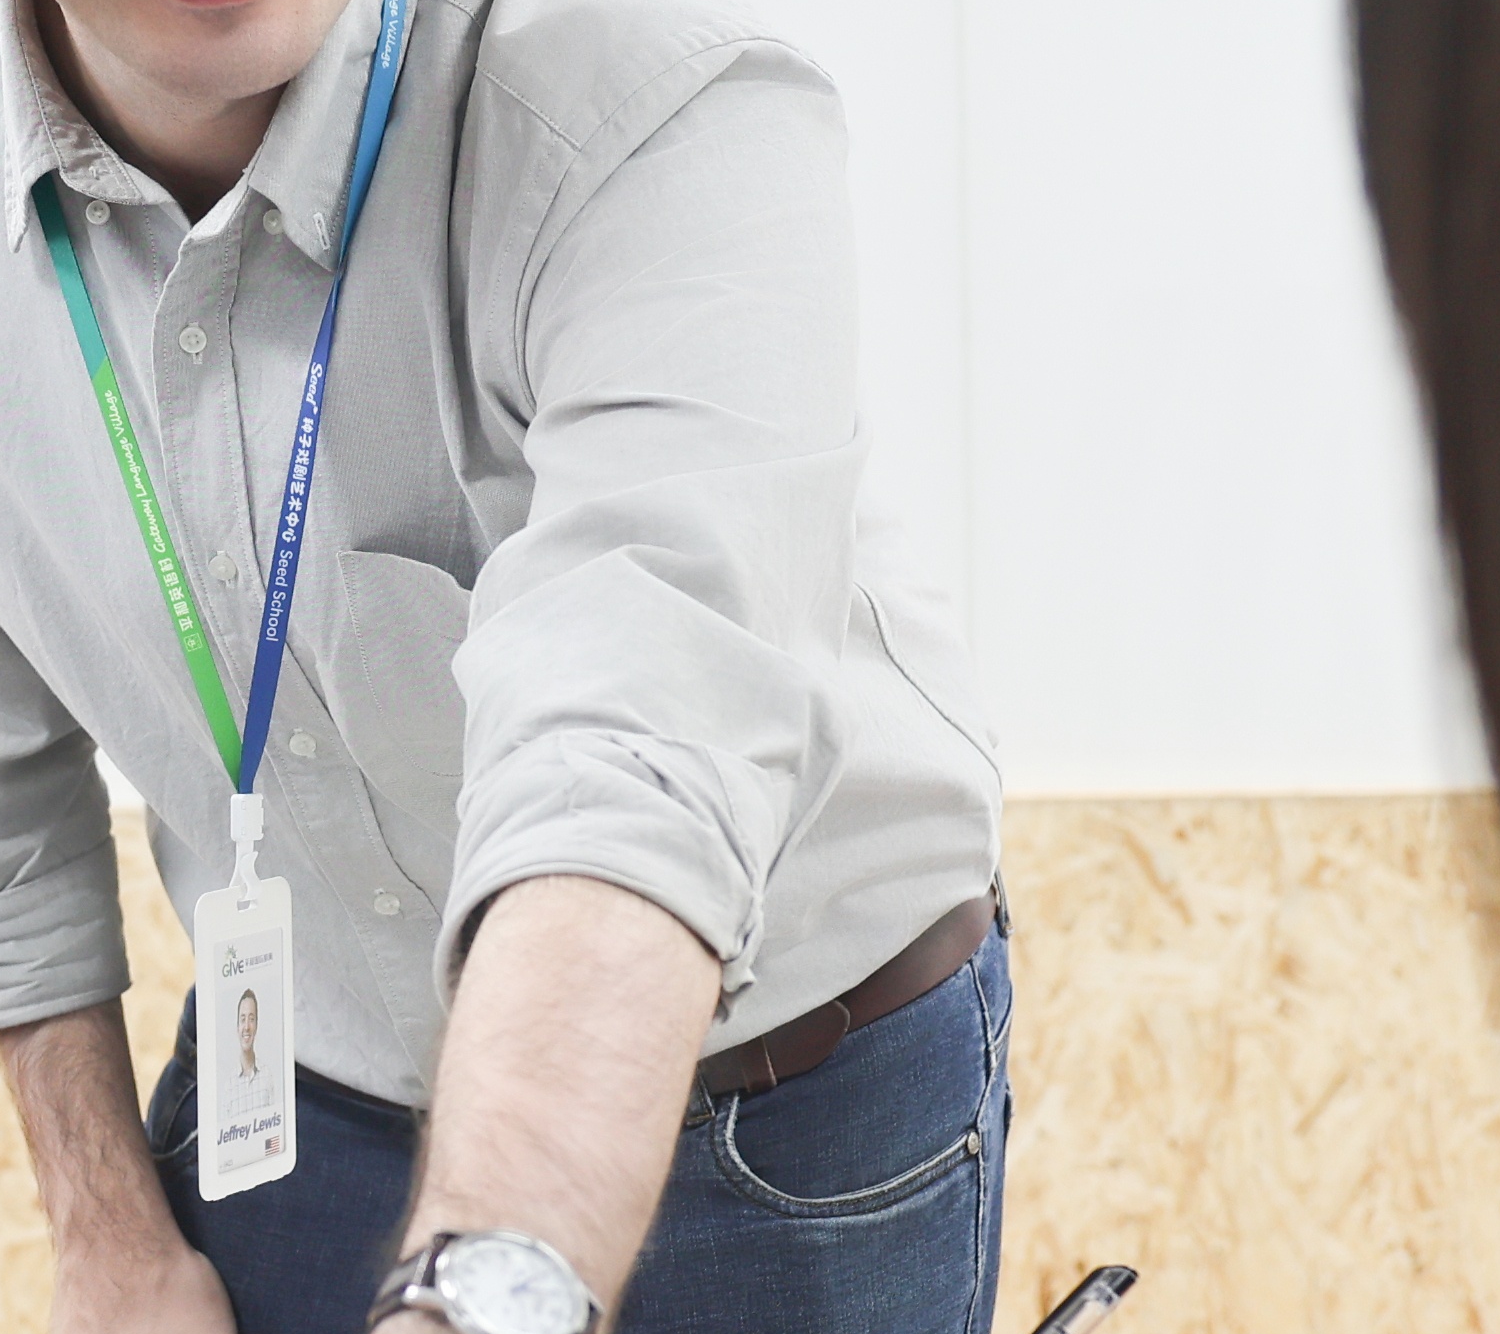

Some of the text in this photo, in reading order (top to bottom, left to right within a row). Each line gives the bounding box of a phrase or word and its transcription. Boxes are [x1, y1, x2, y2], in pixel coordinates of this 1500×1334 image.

[380, 19, 400, 69] Village
[304, 361, 324, 407] Seed
[103, 388, 167, 553] Gateway Language Village
[281, 416, 316, 543] 种子戏剧艺术中心
[157, 556, 195, 633] 平和英语村
[265, 549, 294, 643] Seed School
[217, 1112, 281, 1146] Jeffrey Lewis
